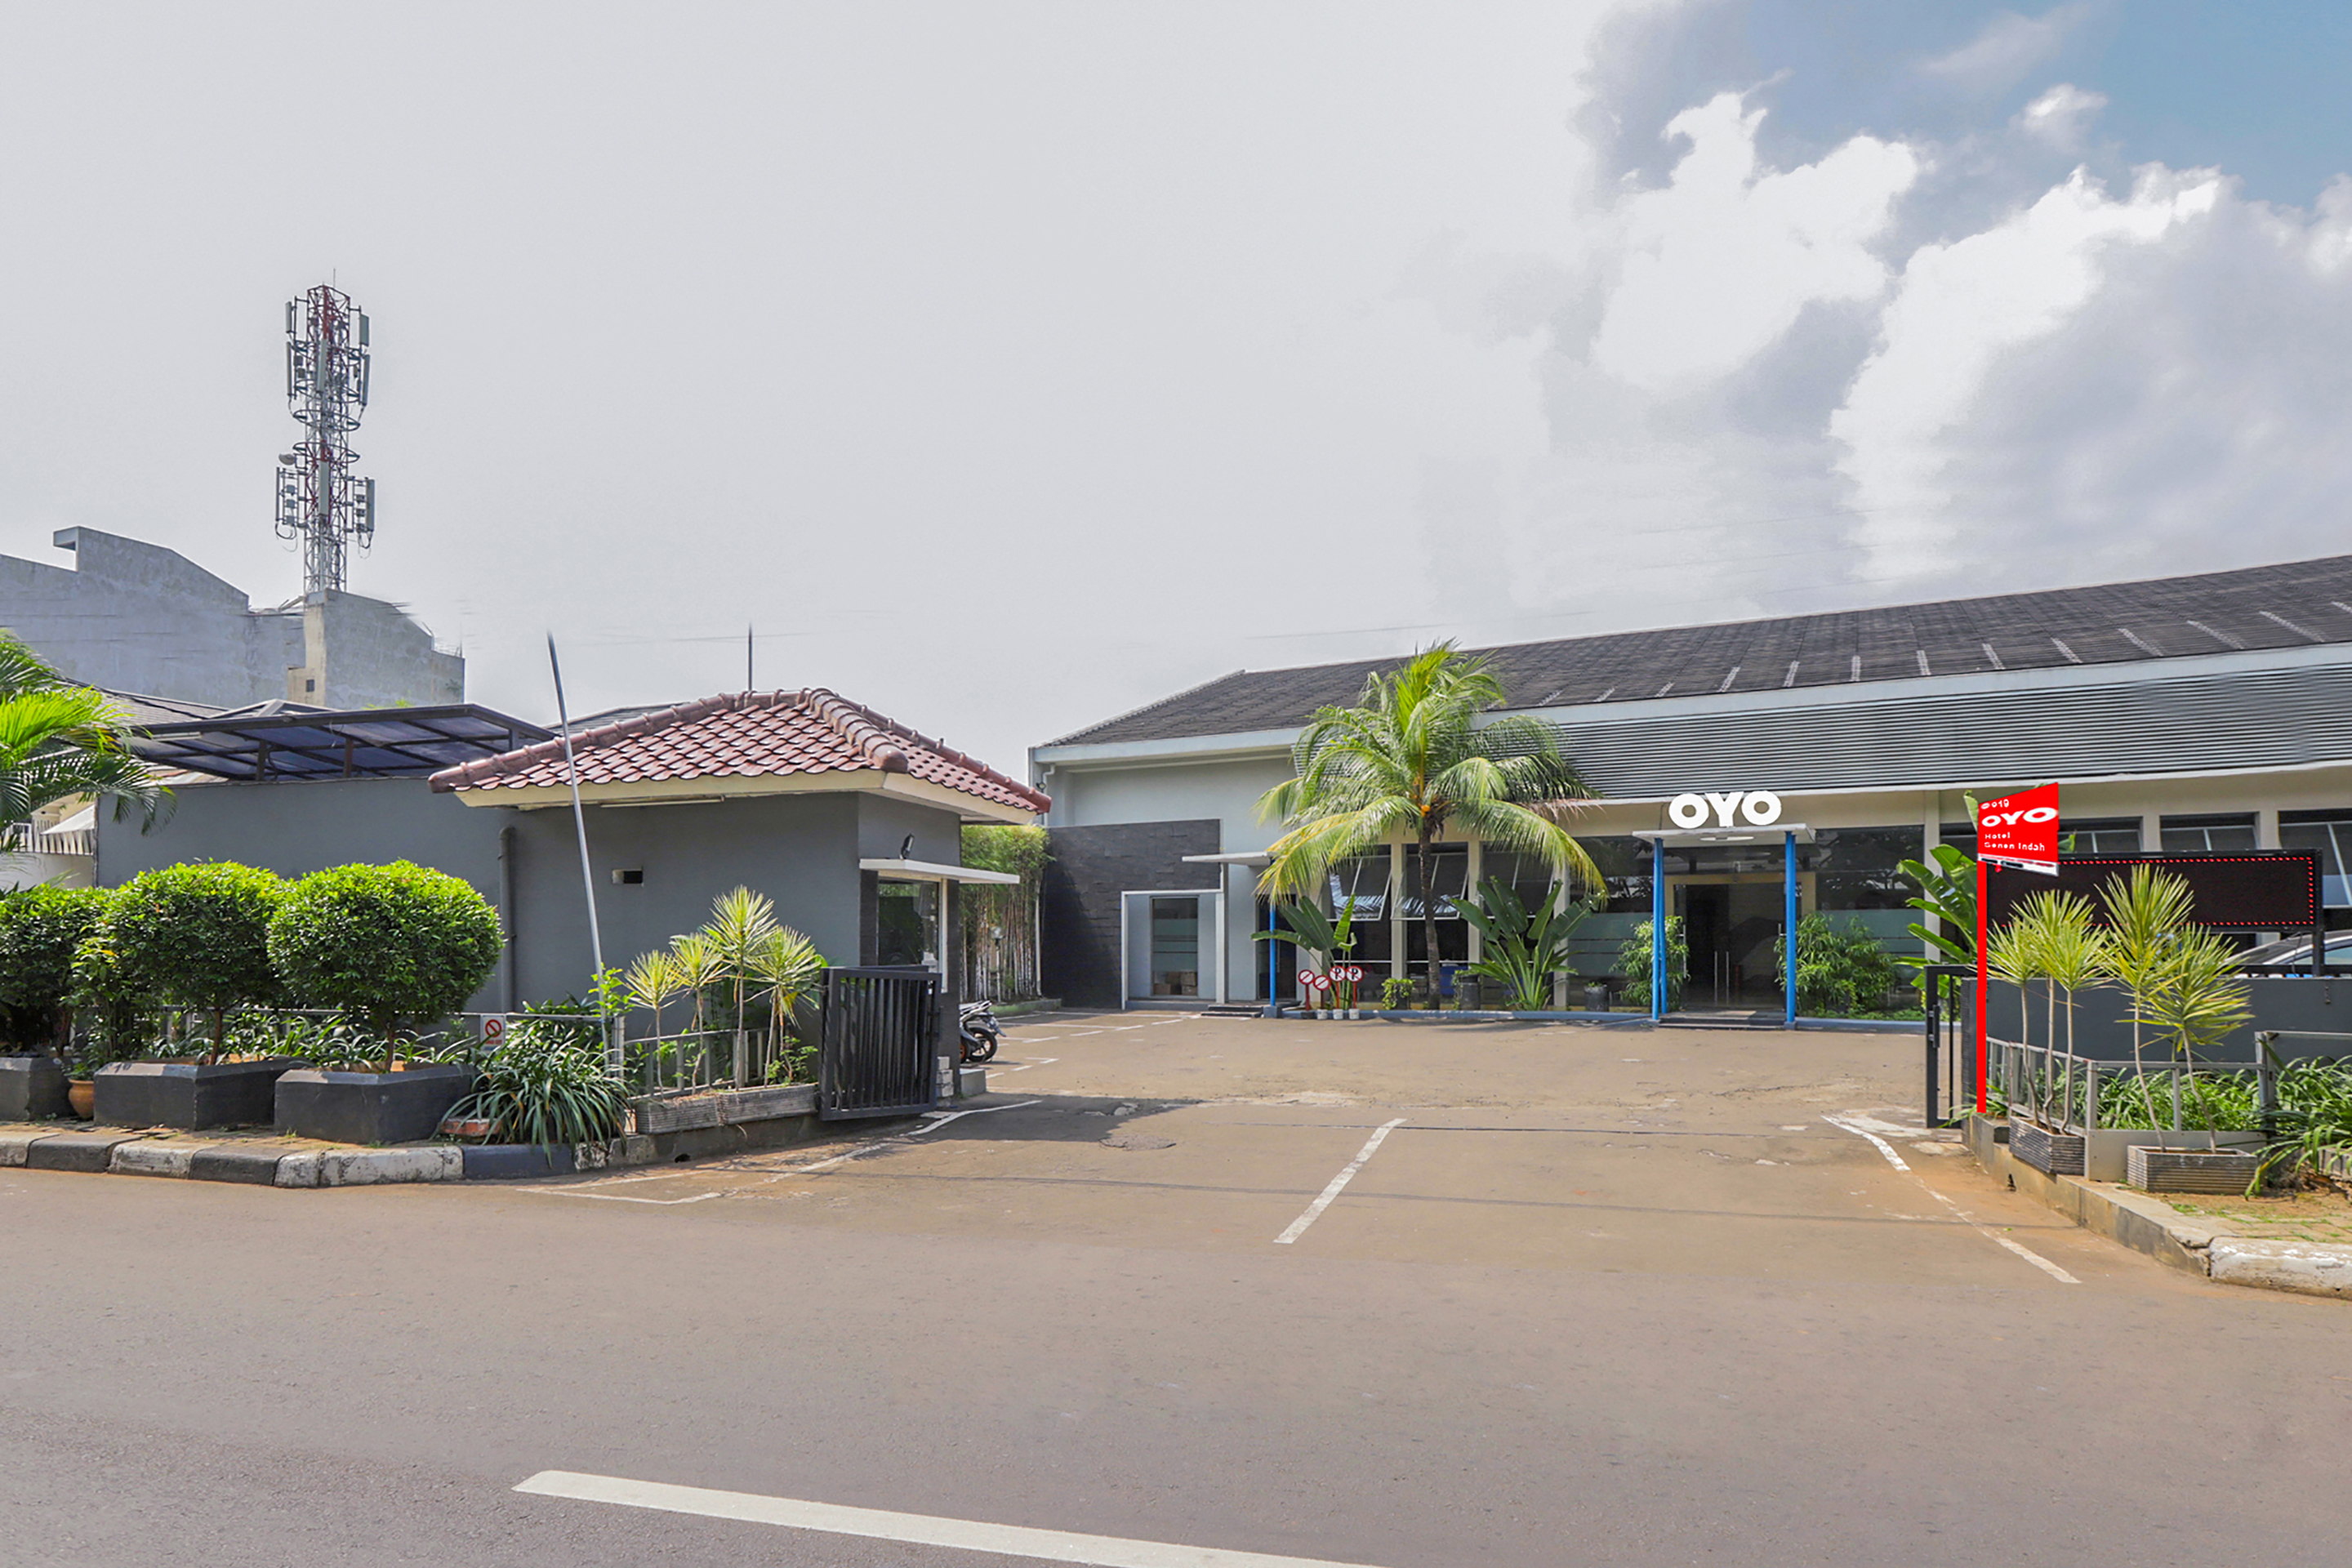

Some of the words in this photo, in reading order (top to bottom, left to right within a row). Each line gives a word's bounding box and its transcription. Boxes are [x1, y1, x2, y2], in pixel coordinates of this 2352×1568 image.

[1668, 791, 1782, 829] OYO
[1981, 807, 2057, 827] OYO
[1984, 831, 2010, 840] Hotel
